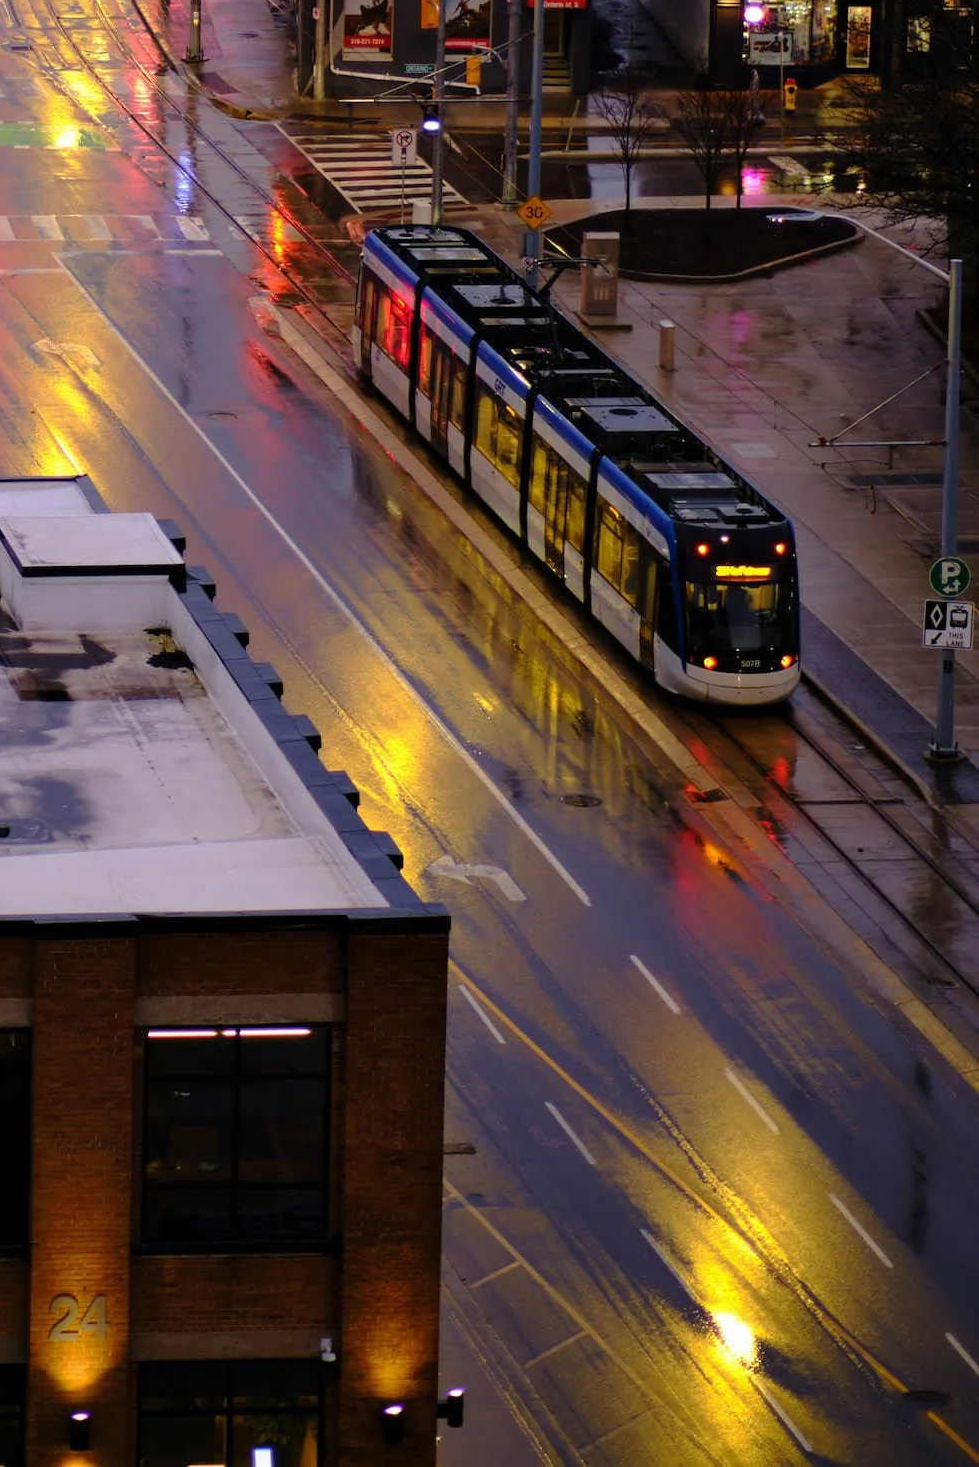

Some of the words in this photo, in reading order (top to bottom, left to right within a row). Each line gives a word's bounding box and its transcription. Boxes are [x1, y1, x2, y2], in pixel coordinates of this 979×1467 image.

[405, 64, 429, 73] ONTARIO
[948, 632, 964, 640] THIS
[946, 640, 965, 648] LANE
[47, 1292, 110, 1341] 24
